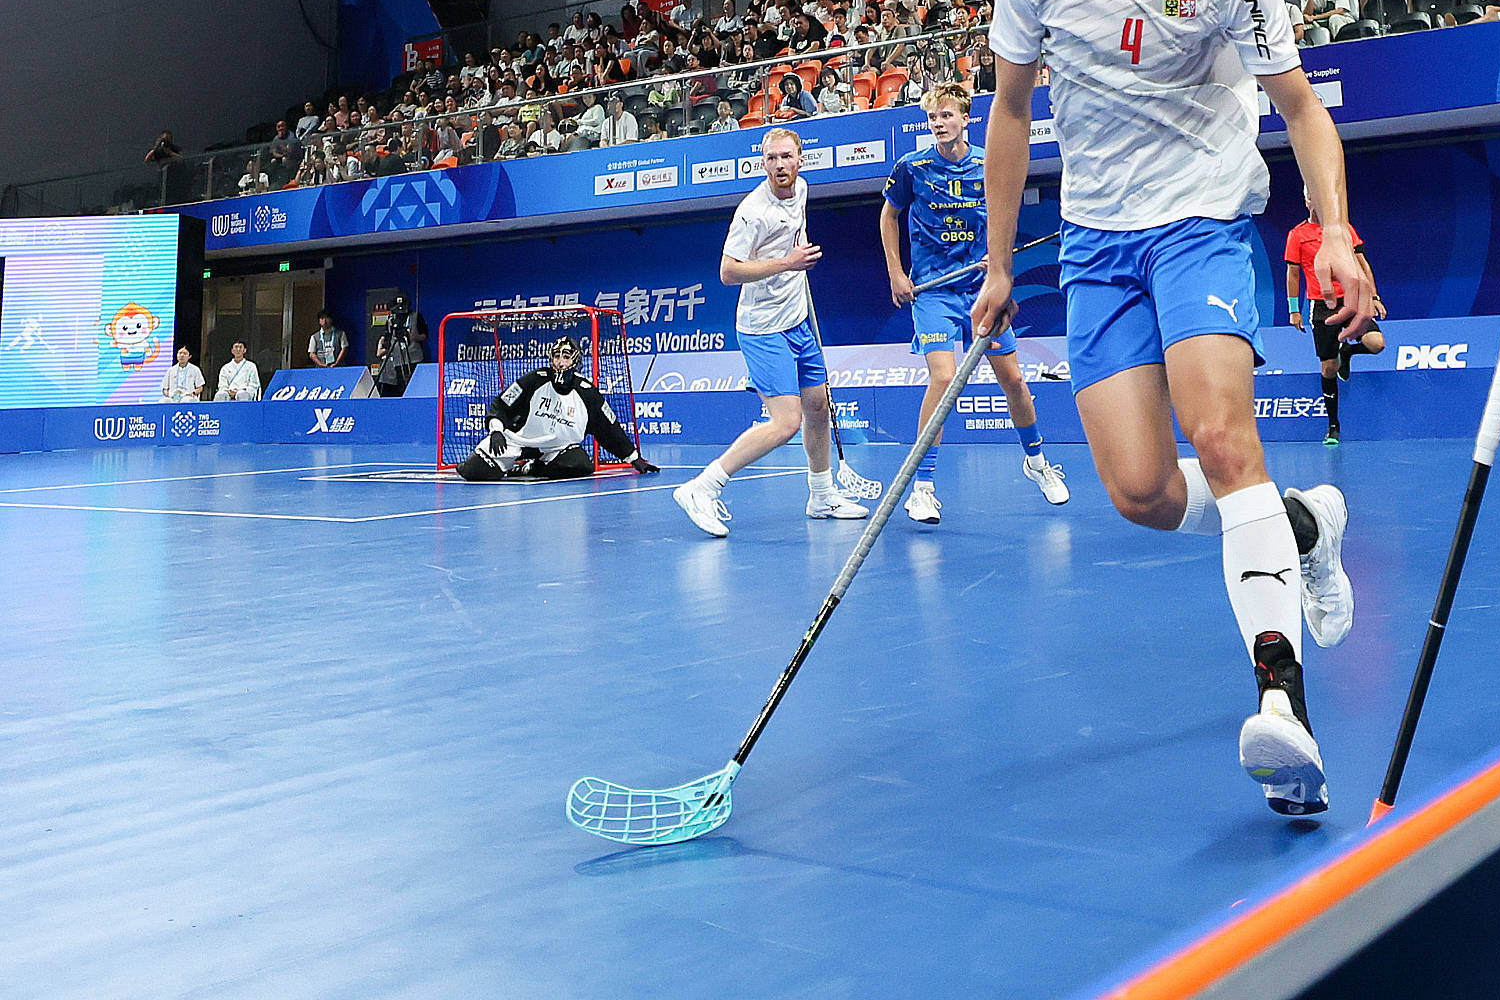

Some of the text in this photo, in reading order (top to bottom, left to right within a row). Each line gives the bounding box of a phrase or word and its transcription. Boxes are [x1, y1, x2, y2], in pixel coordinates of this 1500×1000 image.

[1120, 18, 1144, 64] 4
[1313, 67, 1340, 78] Supplier
[801, 152, 823, 161] EELY
[941, 231, 975, 242] OBOS
[655, 332, 725, 353] Wonders
[1397, 344, 1468, 370] PICC
[541, 397, 552, 411] 74
[634, 402, 663, 418] PICC
[1253, 397, 1329, 418] 亚信安全
[198, 420, 220, 429] 2025
[534, 410, 576, 428] UNIHOC
[129, 423, 156, 431] WORLD
[129, 430, 156, 438] GAMES
